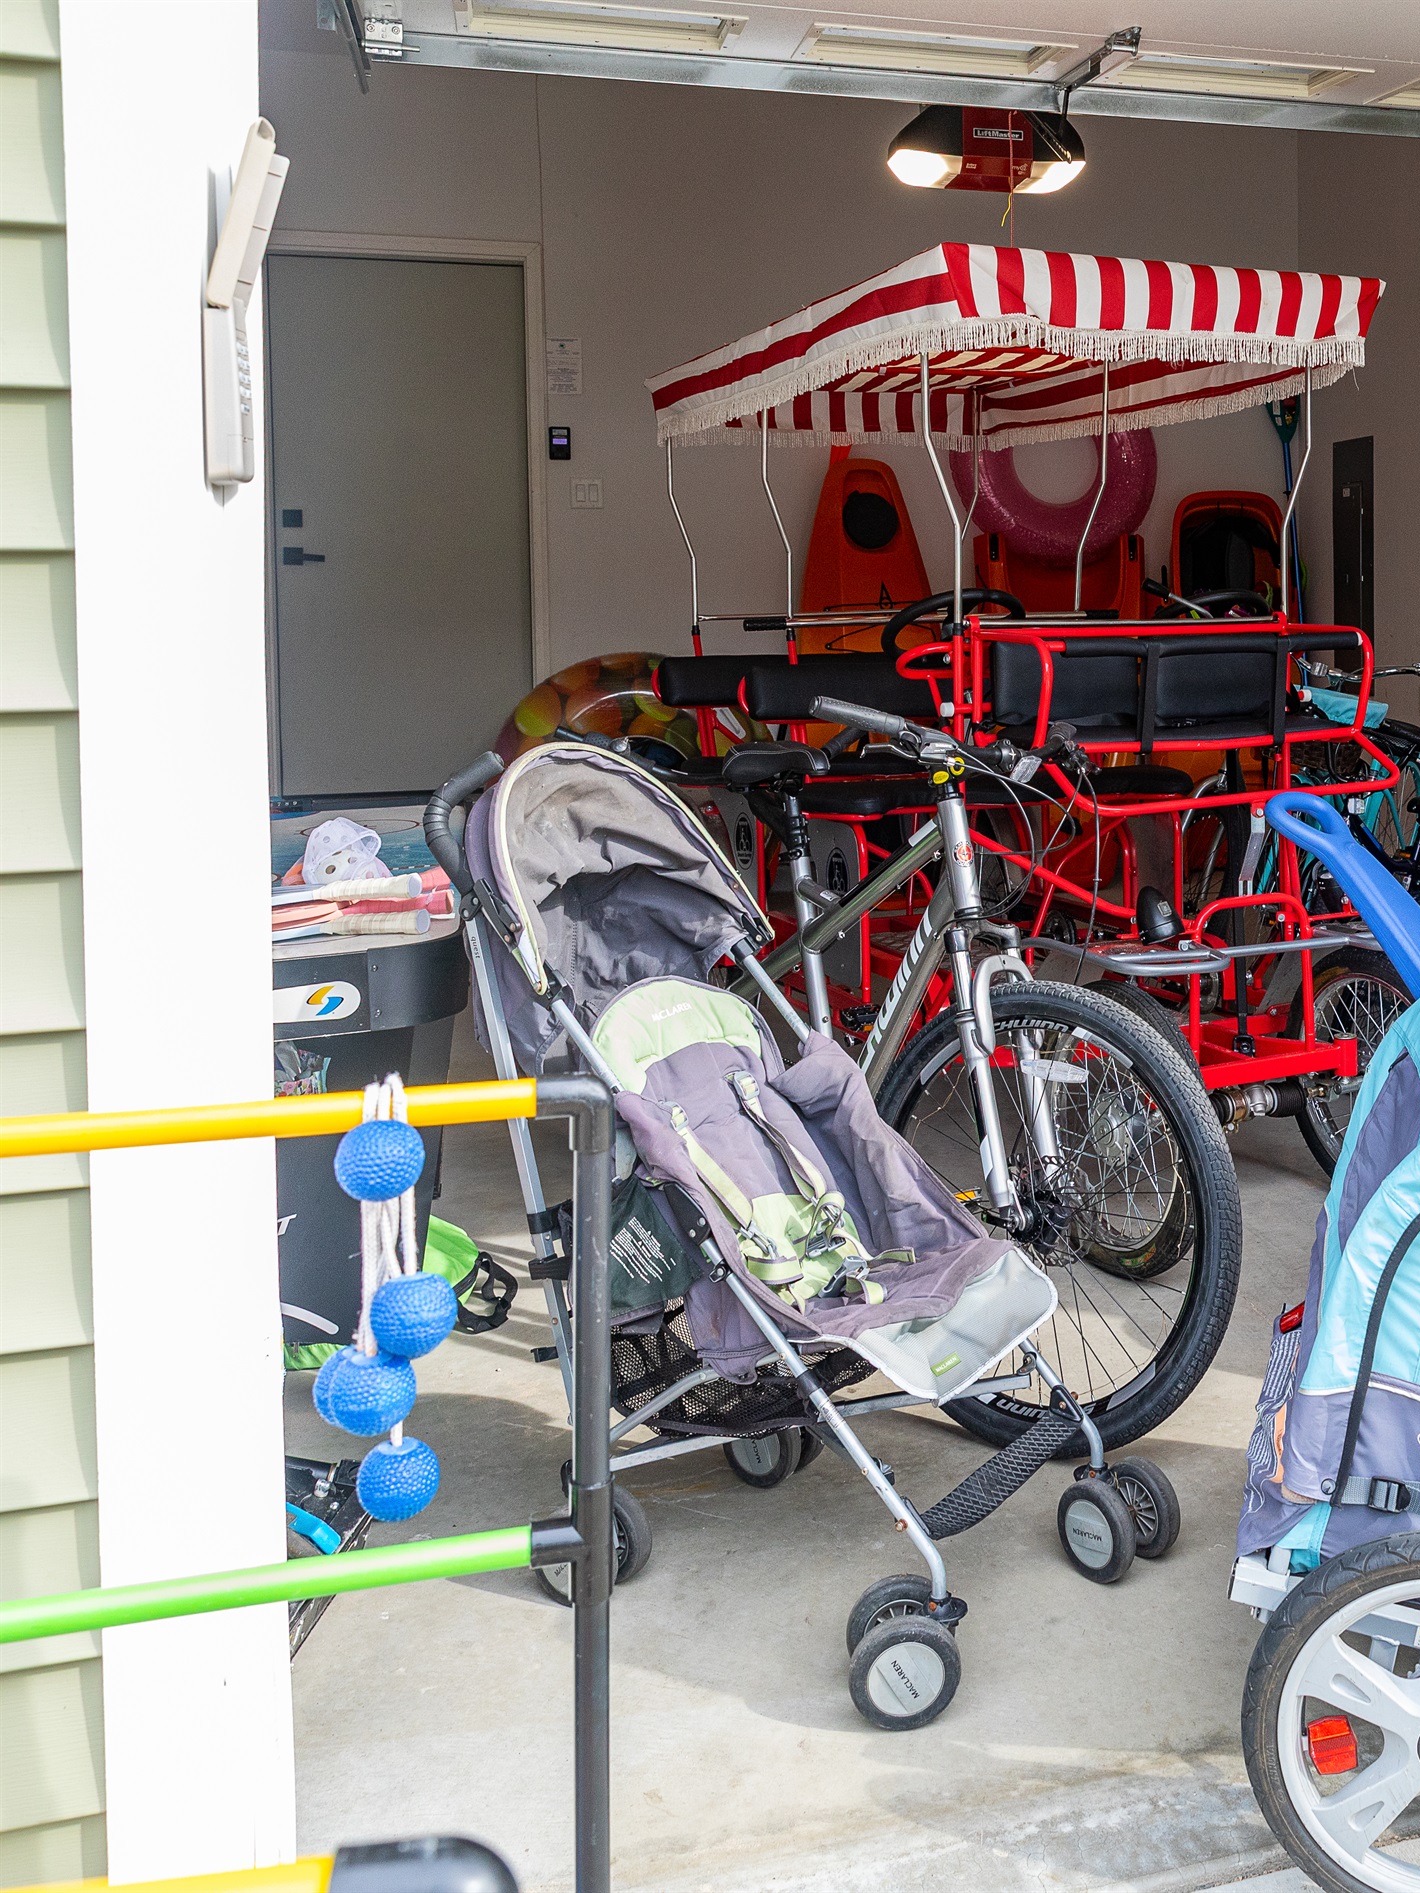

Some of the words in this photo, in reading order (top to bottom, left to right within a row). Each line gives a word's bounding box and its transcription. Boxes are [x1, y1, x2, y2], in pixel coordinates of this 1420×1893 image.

[977, 129, 1020, 139] LiftMaster
[470, 936, 481, 959] quest
[857, 905, 934, 1075] CHWINN
[994, 1019, 1069, 1033] CHWINN
[1072, 1527, 1103, 1542] MACLAREN
[890, 1659, 920, 1699] MACLAREN
